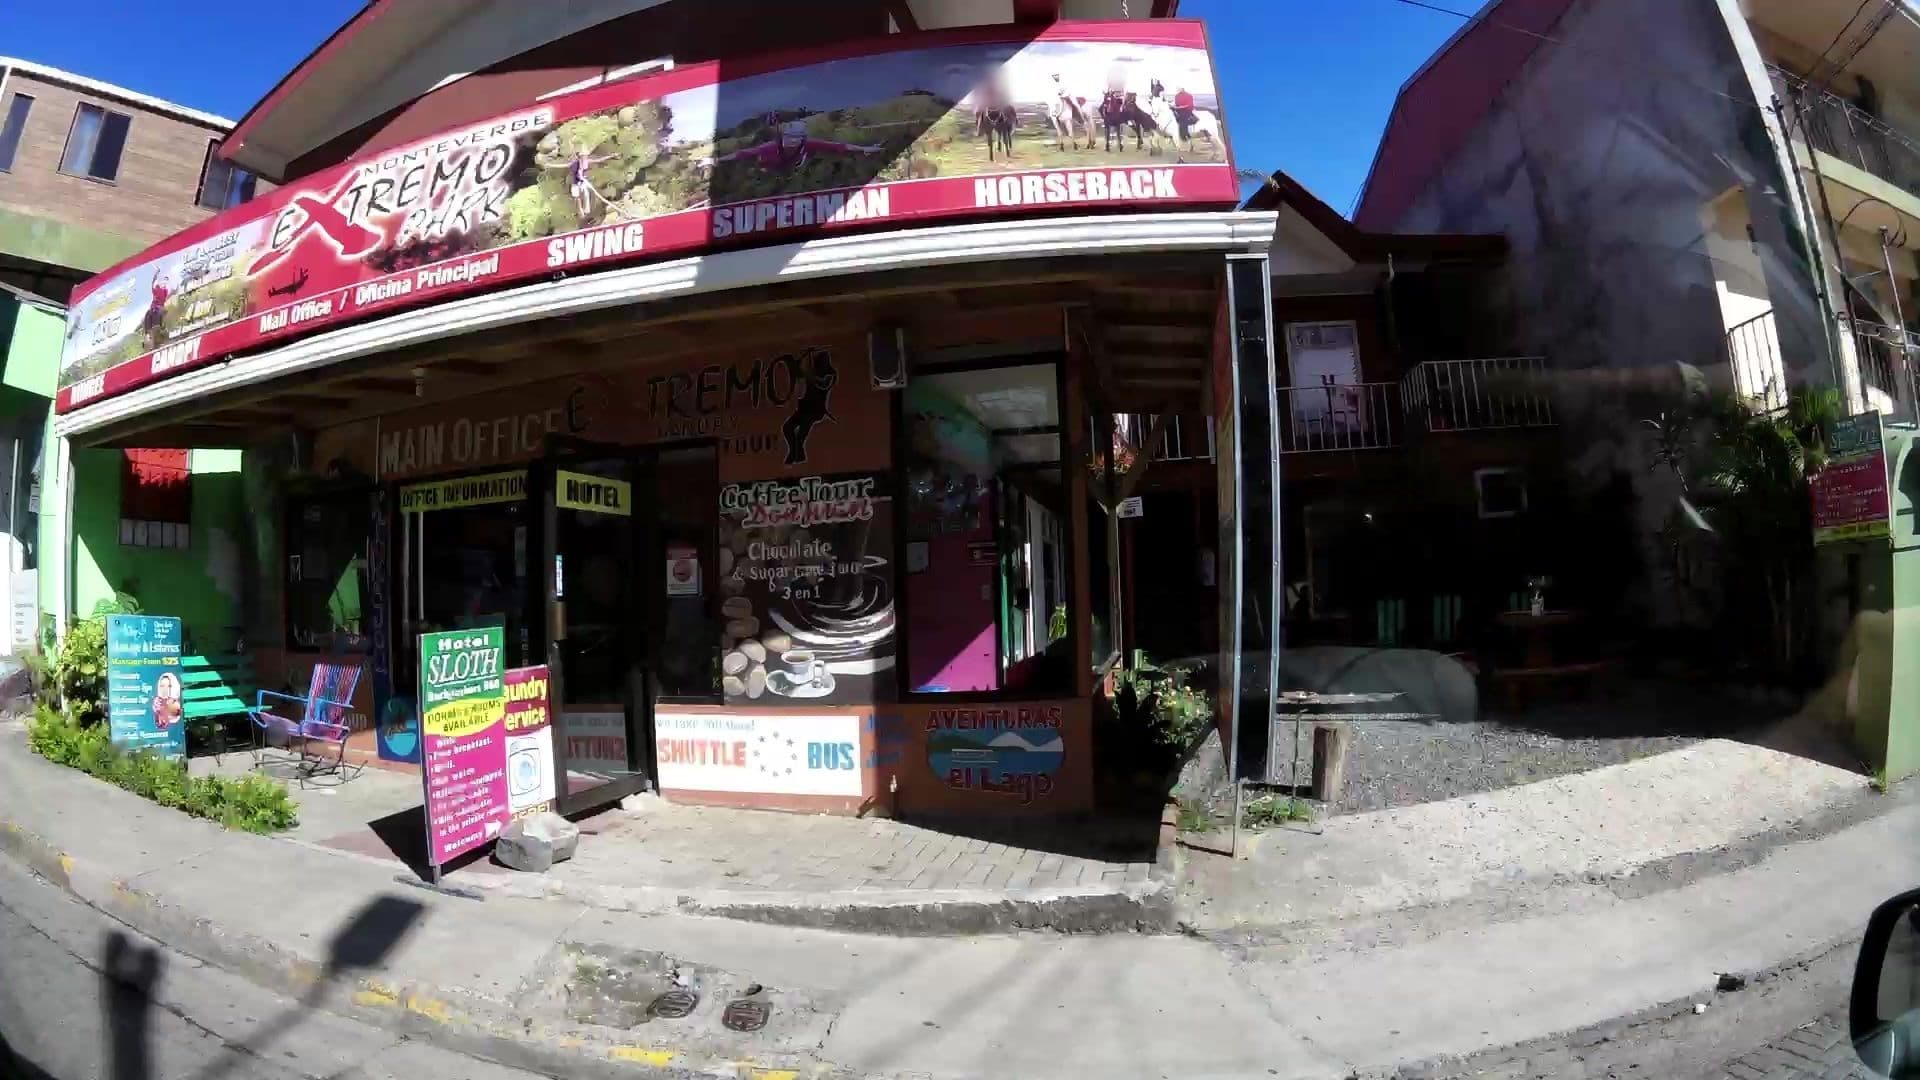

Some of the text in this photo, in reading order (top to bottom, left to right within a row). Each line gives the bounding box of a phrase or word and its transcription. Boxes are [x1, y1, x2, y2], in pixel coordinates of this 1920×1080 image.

[363, 113, 550, 177] MONTEVERDE
[974, 168, 1178, 208] HORSEBACK
[713, 187, 890, 238] SUPERMAN
[547, 222, 643, 268] SWING
[416, 253, 499, 290] Principal
[381, 408, 560, 473] MAIN OFFICE
[566, 479, 621, 508] HOTEL
[748, 538, 832, 561] Chocolate
[781, 586, 791, 600] 3
[795, 587, 811, 600] en
[438, 634, 489, 651] Hotel
[427, 647, 500, 685] SLOTH
[504, 675, 548, 703] aundry
[505, 704, 547, 731] ervice
[920, 704, 1064, 733] AVENTURAS
[657, 738, 747, 768] SHUTTLE
[807, 741, 855, 770] BUS
